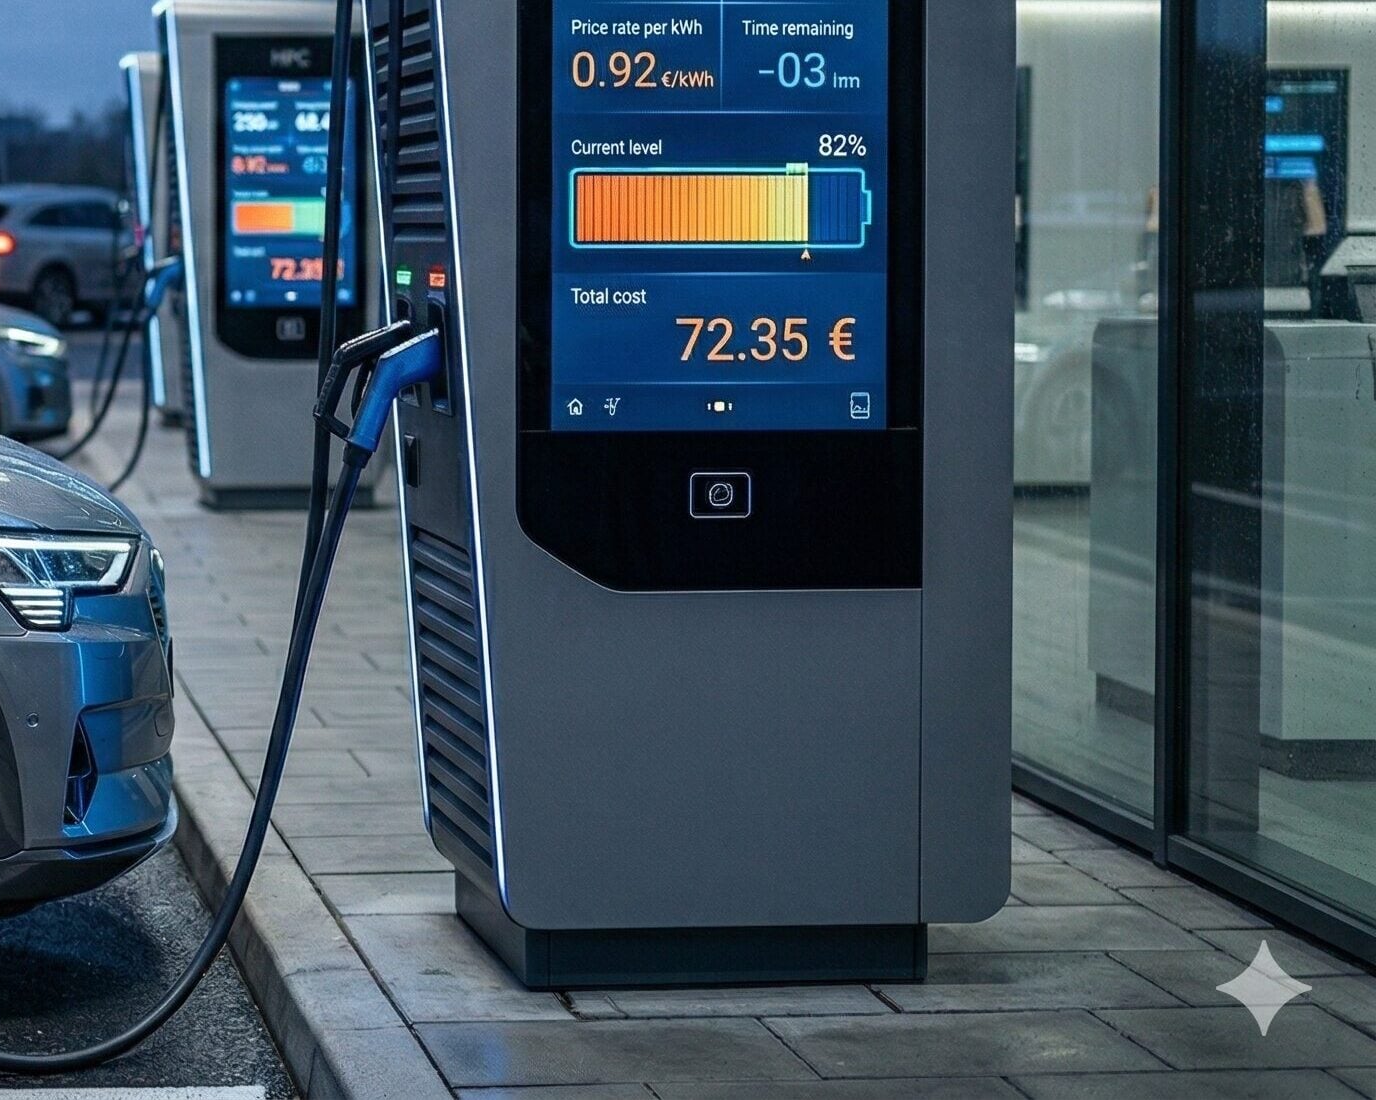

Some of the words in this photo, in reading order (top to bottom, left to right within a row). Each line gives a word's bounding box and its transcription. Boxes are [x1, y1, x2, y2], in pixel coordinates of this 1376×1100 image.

[571, 19, 609, 35] Price
[612, 20, 641, 35] rate
[644, 23, 668, 39] per
[671, 19, 703, 35] kWh
[742, 19, 779, 36] Time
[782, 19, 854, 39] remaining
[572, 51, 657, 88] 0.92
[661, 70, 714, 88] €/kWh
[571, 139, 625, 155] Current
[629, 139, 662, 155] level
[818, 133, 867, 157] 82%
[570, 287, 609, 305] Total
[612, 289, 647, 305] cost
[675, 317, 808, 361] 72.35
[828, 317, 856, 361] €
